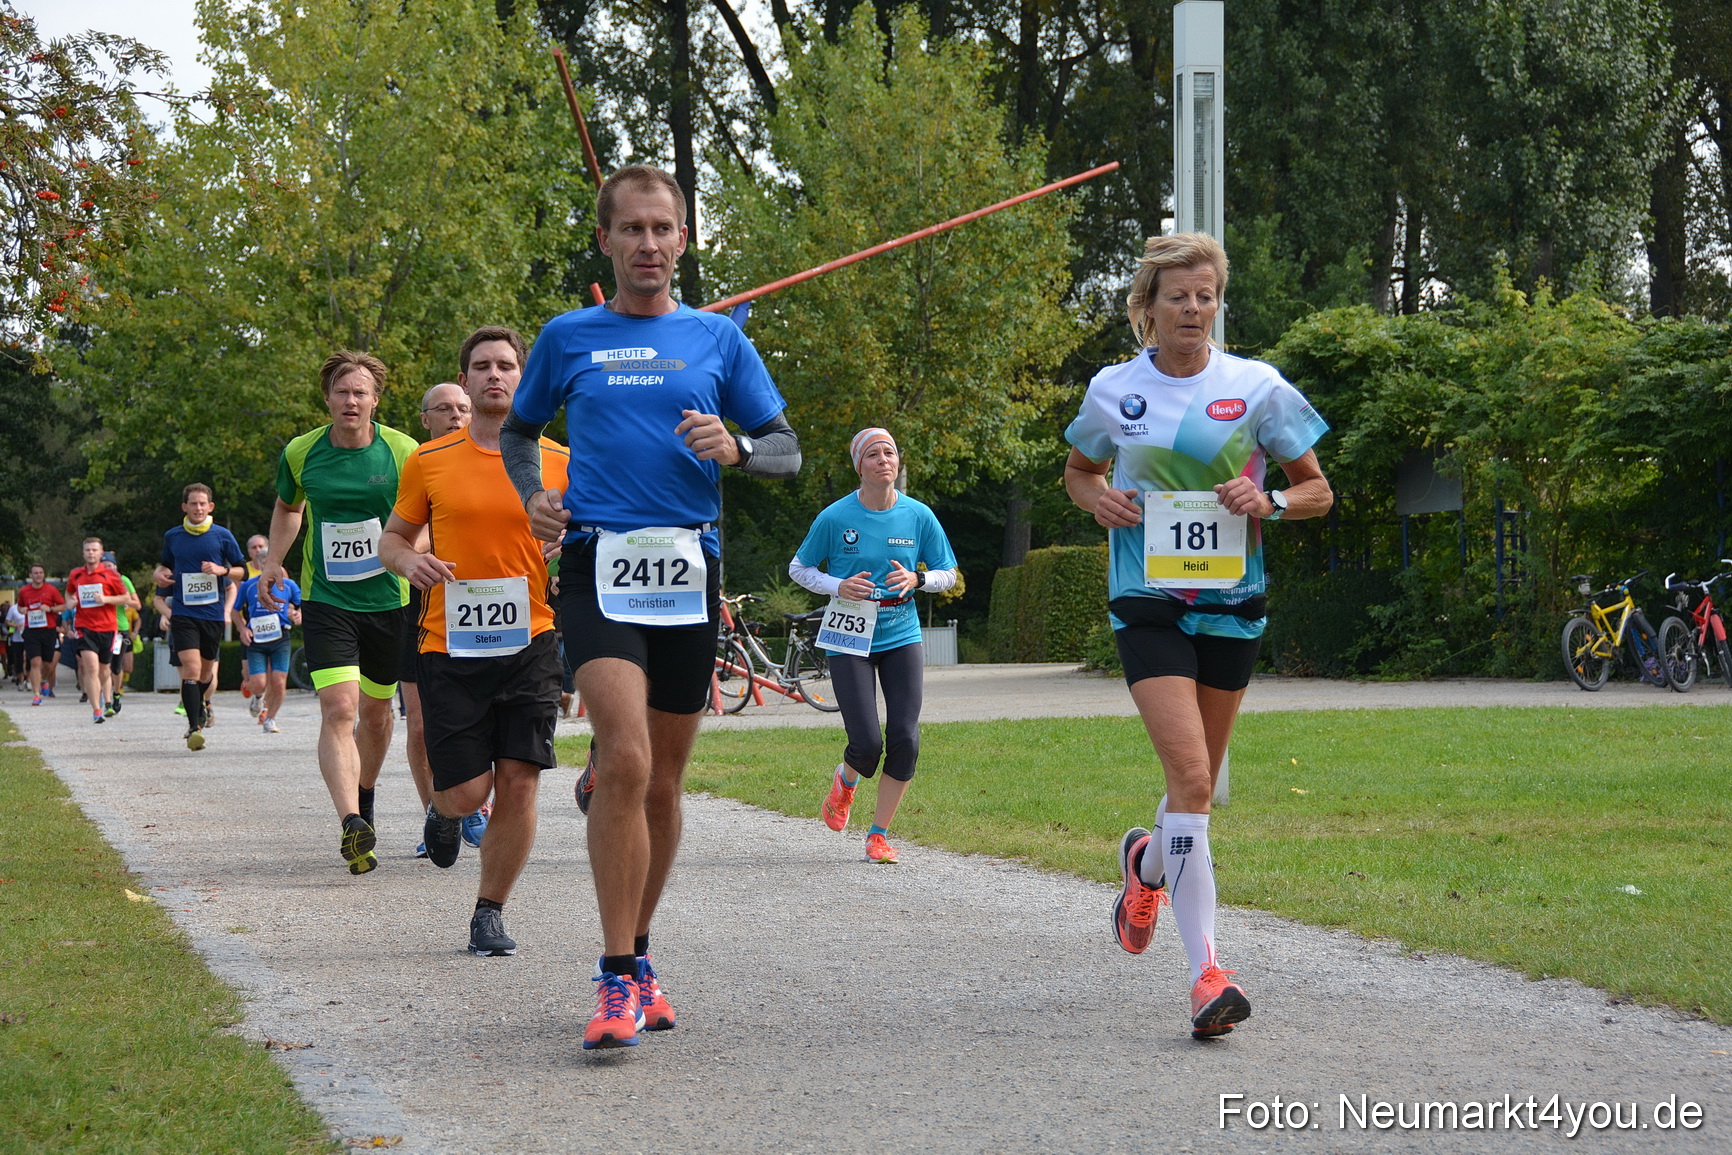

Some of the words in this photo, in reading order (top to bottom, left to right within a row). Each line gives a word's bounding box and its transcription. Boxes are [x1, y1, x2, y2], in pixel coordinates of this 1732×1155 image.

[607, 349, 647, 359] HEUTE
[619, 360, 677, 369] MORGEN
[608, 375, 664, 385] BEWEGEN
[1184, 501, 1218, 509] BOCK
[1169, 521, 1218, 551] 181
[331, 538, 373, 559] 2761
[1183, 560, 1209, 571] Heidi
[612, 558, 690, 587] 2412
[187, 581, 213, 593] 2558
[628, 598, 676, 609] Christian
[457, 602, 518, 627] 2120
[255, 623, 276, 632] 2466
[828, 611, 866, 633] 2753
[475, 634, 502, 644] Stefan
[822, 632, 856, 649] ANIKA
